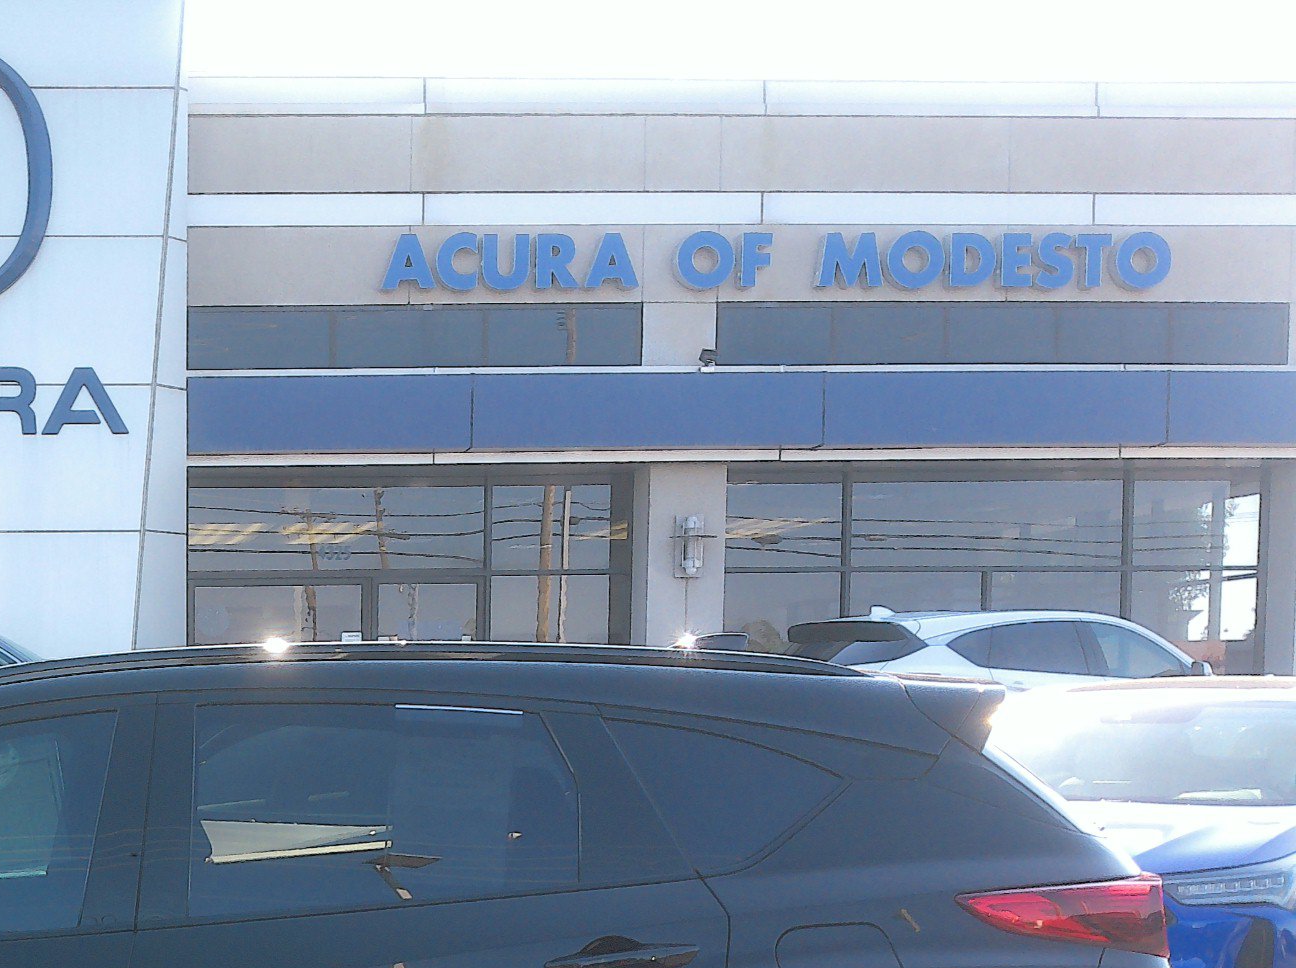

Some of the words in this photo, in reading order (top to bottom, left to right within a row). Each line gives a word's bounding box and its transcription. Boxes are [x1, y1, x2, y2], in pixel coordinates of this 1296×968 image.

[380, 231, 640, 293] ACURA
[673, 230, 775, 291] OF
[814, 229, 1174, 293] MODESTO
